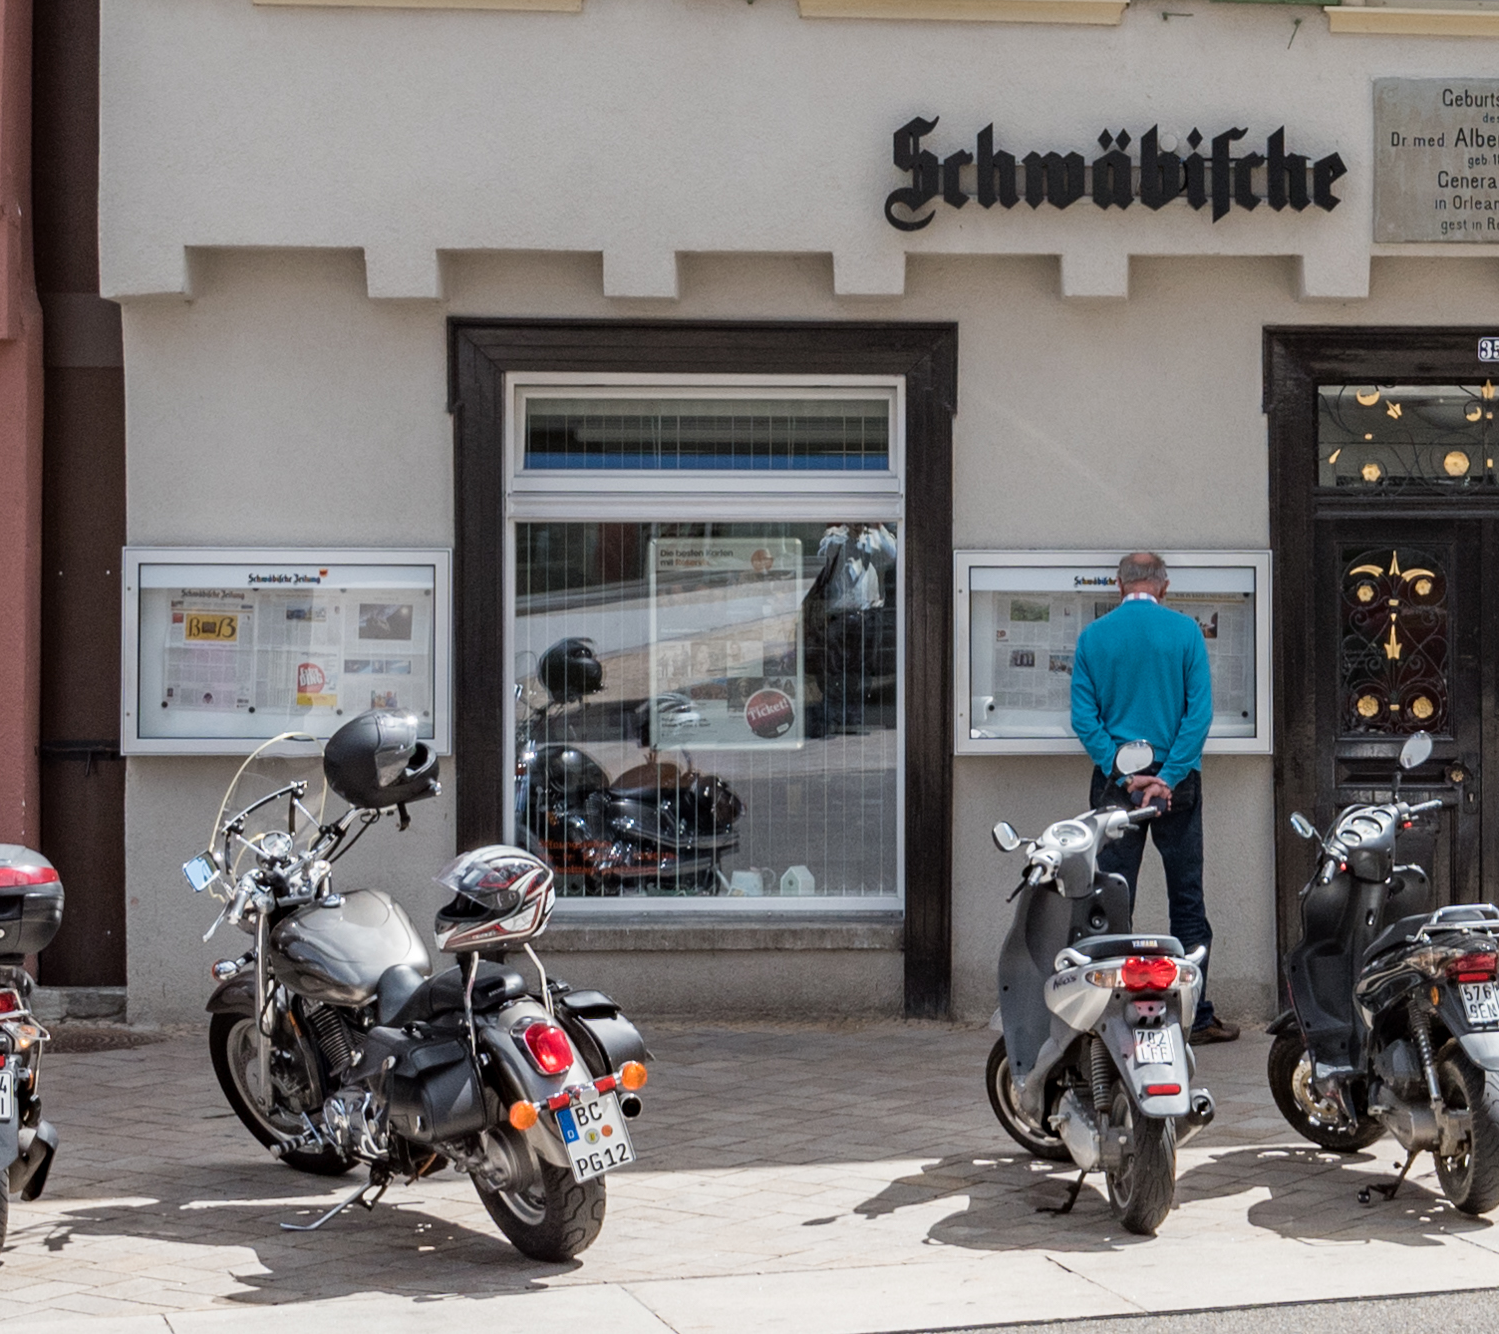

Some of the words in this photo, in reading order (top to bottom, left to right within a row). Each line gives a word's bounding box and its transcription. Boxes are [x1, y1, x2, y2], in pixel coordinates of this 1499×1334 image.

[1435, 199, 1446, 209] in
[1472, 221, 1482, 231] in
[748, 698, 788, 721] Ticket!
[1132, 940, 1158, 948] YAMAHA
[1463, 984, 1491, 1001] 576
[1141, 1047, 1168, 1060] LFF
[575, 1101, 603, 1127] BC
[567, 1130, 575, 1139] D
